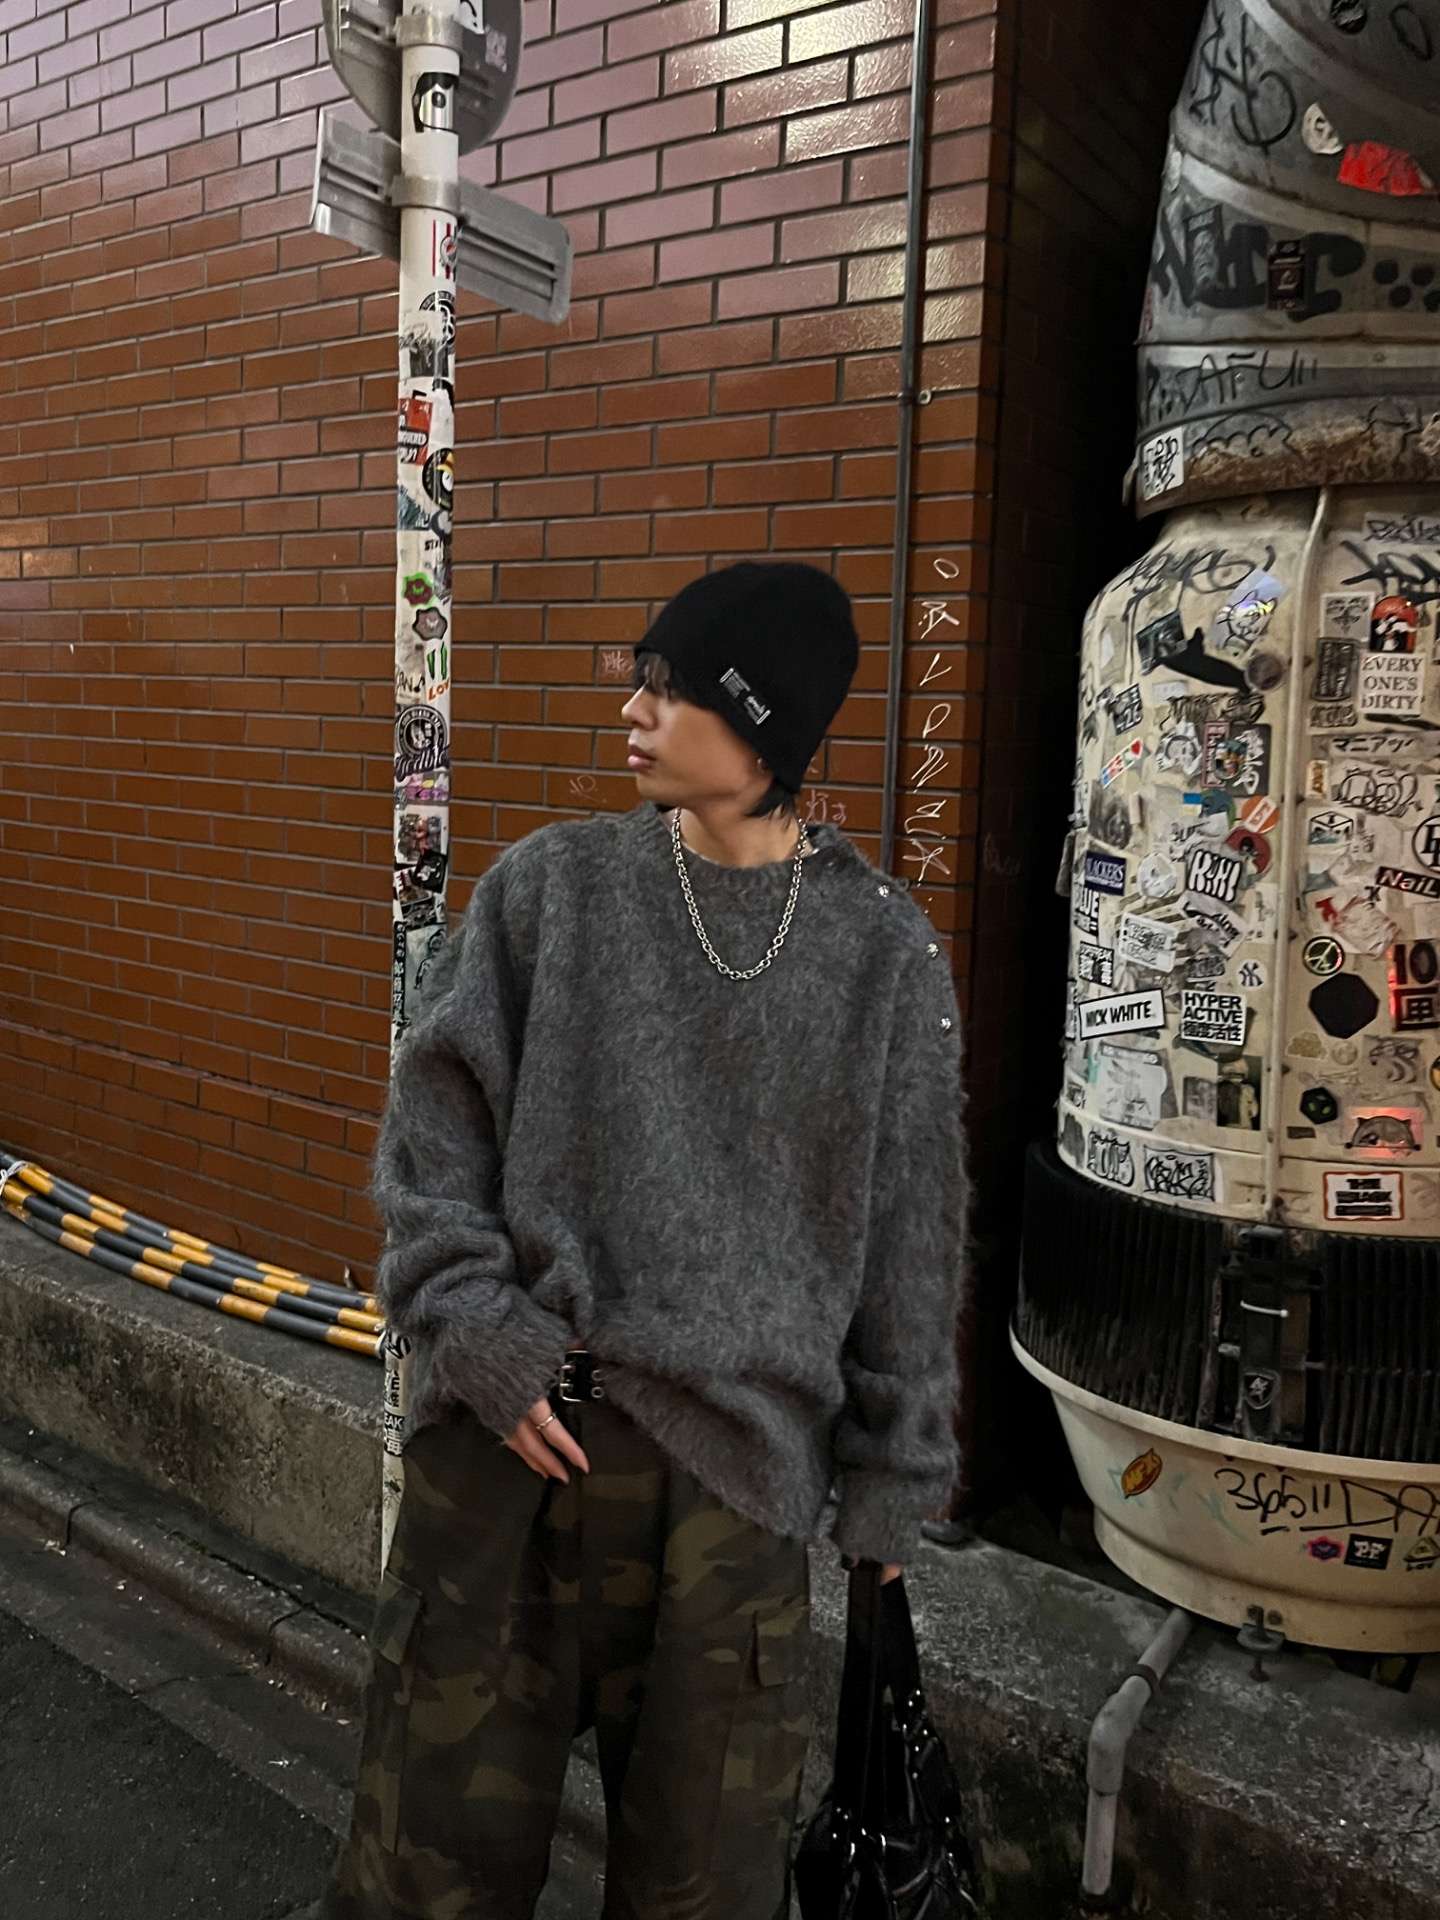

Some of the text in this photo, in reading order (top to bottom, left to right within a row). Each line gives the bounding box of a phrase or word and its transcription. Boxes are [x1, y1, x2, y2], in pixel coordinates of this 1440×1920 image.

[1363, 656, 1422, 671] EVERY
[1362, 694, 1418, 709] DIRTY
[1185, 992, 1242, 1009] HYPER
[1110, 1000, 1152, 1024] WHITE
[1183, 1006, 1243, 1024] ACTIVE
